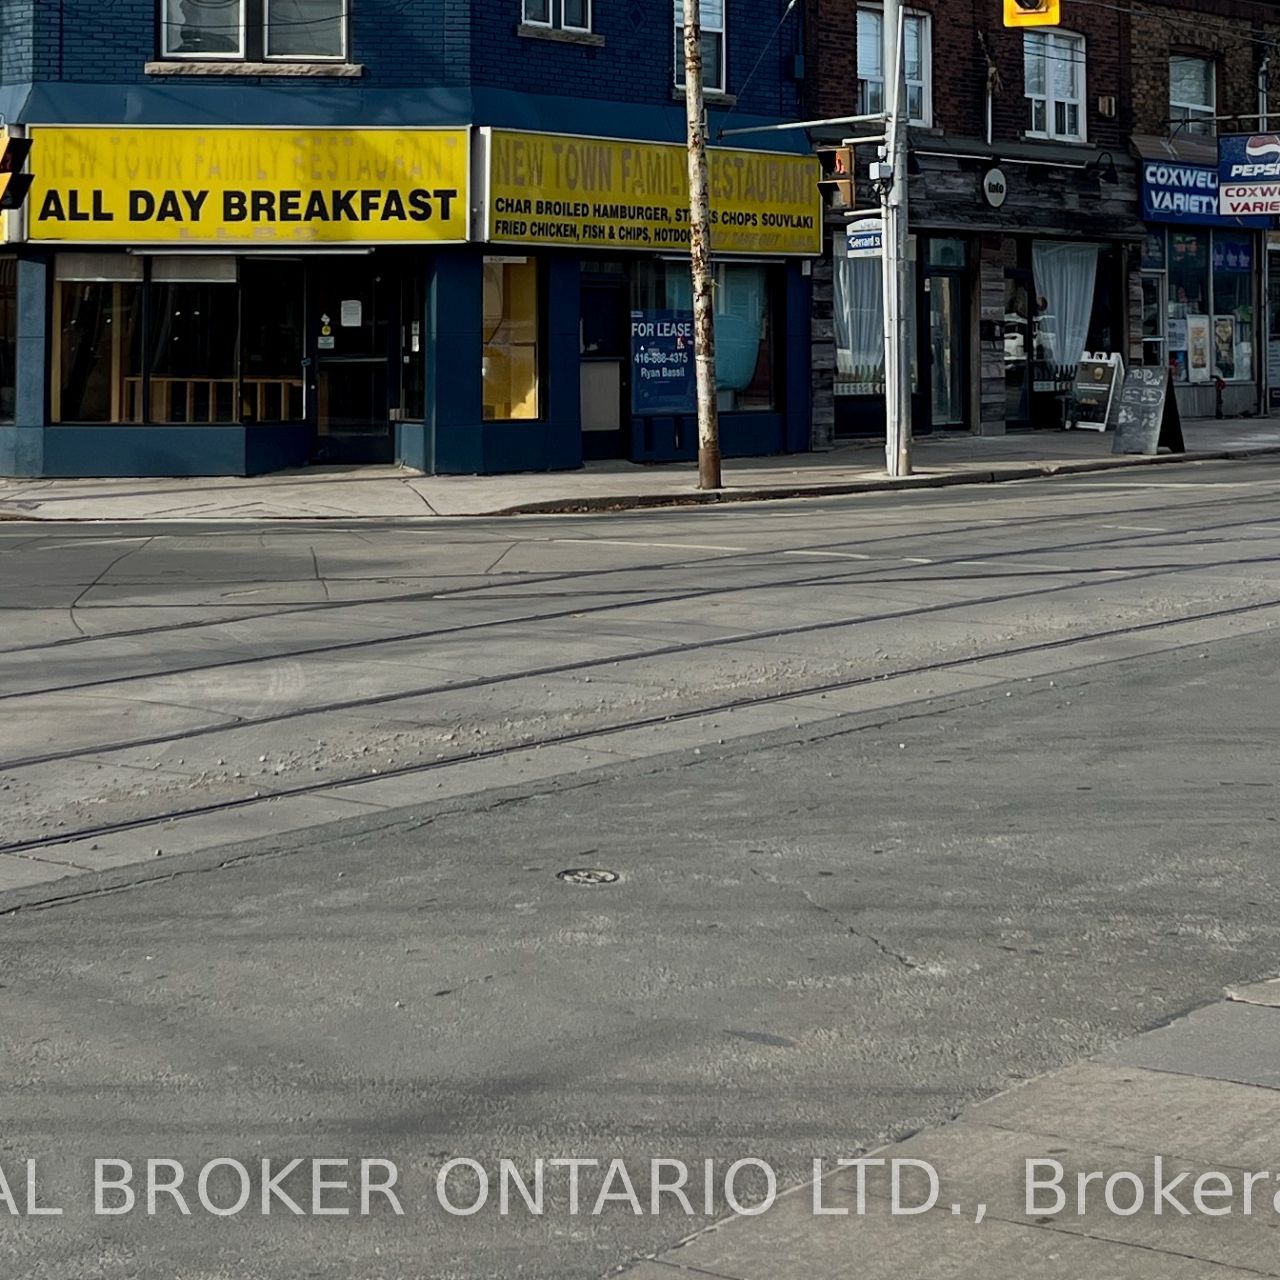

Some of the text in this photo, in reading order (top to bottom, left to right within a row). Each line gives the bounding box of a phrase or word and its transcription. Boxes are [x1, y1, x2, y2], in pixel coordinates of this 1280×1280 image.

[709, 154, 817, 206] ESTAURANT
[38, 188, 458, 222] ALL DAY BREAKFAST
[495, 197, 532, 214] CHAR
[536, 200, 589, 218] BROILED
[593, 203, 672, 224] HAMBURGER,
[721, 211, 758, 227] CHOPS
[762, 213, 813, 229] SOUVLAKI
[1150, 190, 1219, 216] VARIETY
[495, 220, 527, 236] FRIED
[530, 222, 580, 241] CHICKEN,
[583, 224, 606, 240] FISH
[608, 225, 616, 240] &
[619, 225, 651, 244] CHIPS,
[631, 322, 691, 337] FOR LEASE
[641, 366, 685, 380] Ryan Bassil
